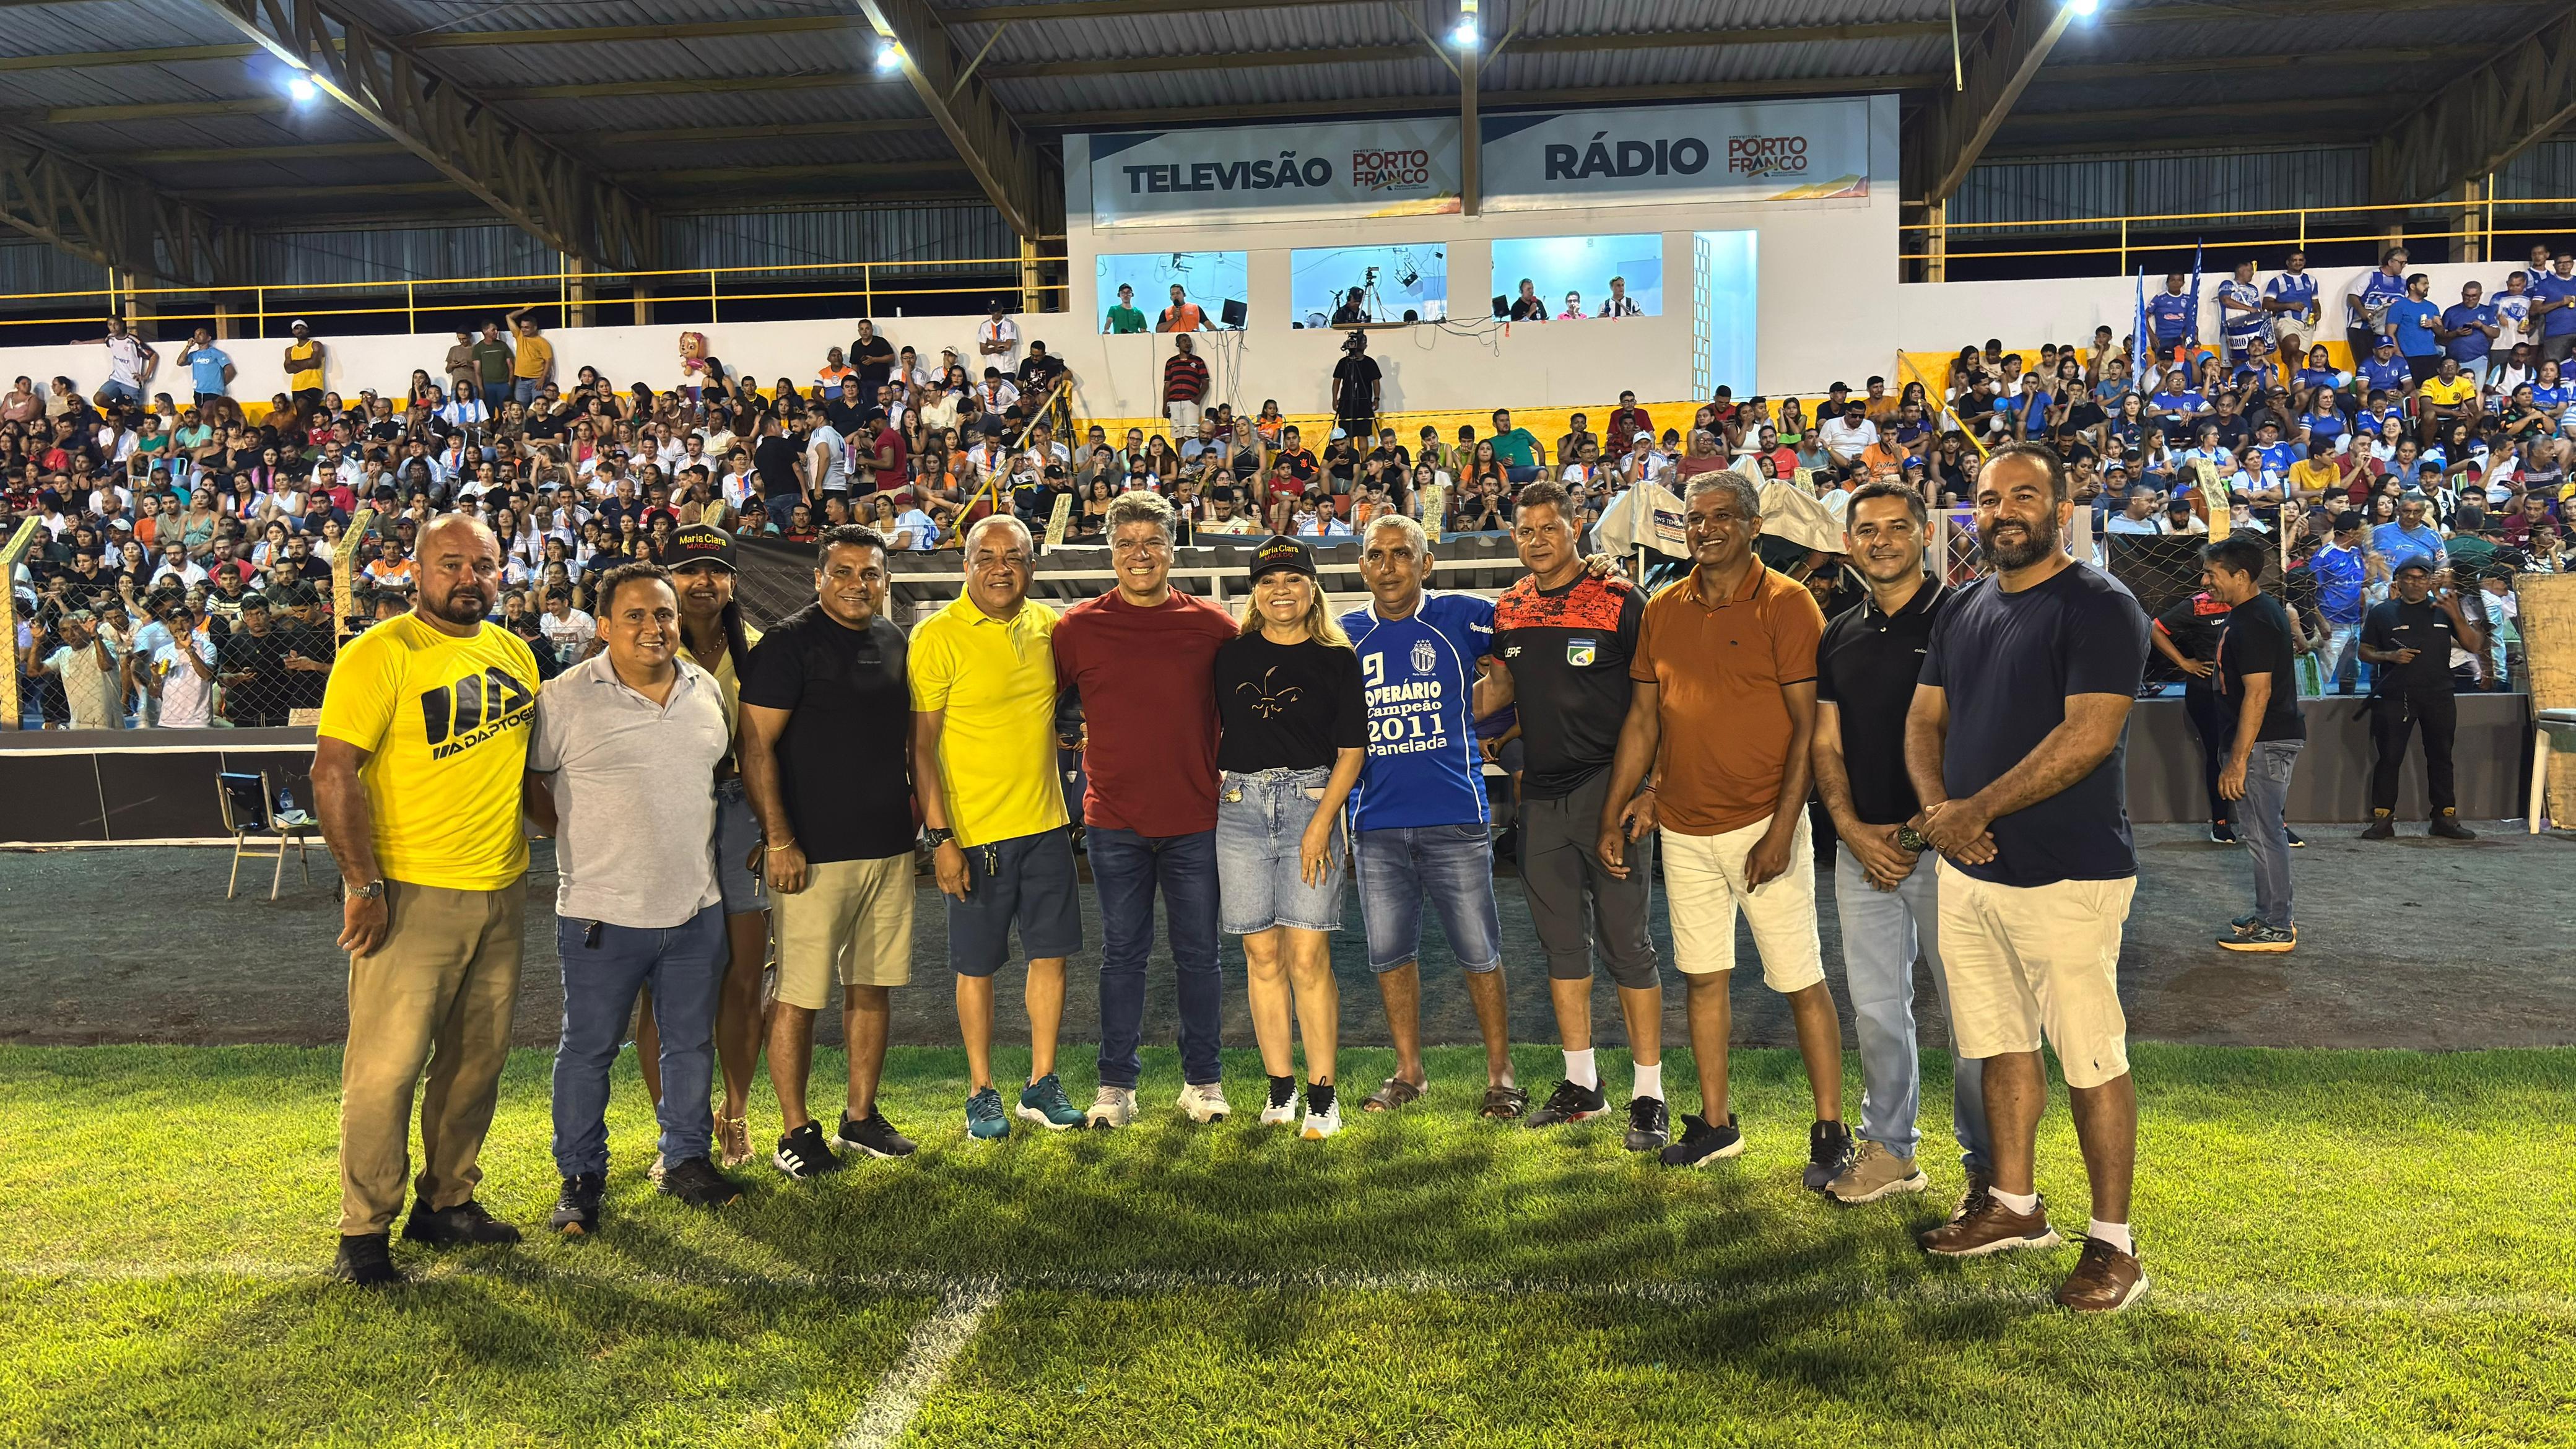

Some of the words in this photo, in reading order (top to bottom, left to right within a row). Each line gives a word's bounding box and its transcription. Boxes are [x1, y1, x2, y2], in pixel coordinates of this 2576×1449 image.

[1545, 131, 1709, 180] RÁDIO
[1728, 136, 1808, 157] PORTO
[1353, 149, 1429, 172] PORTO
[1728, 155, 1808, 173] FRANCO
[1123, 150, 1333, 194] TELEVISÃO
[1353, 168, 1429, 187] FRANCO
[680, 534, 703, 545] Maria
[704, 533, 726, 546] Clara
[1260, 546, 1278, 558] Maria
[1279, 545, 1299, 553] Clara
[1469, 622, 1494, 634] Operário
[1364, 678, 1442, 708] OPERÁRIO
[1367, 700, 1442, 719] Campeão
[1367, 713, 1445, 743] 2011
[1367, 736, 1447, 757] Panelada
